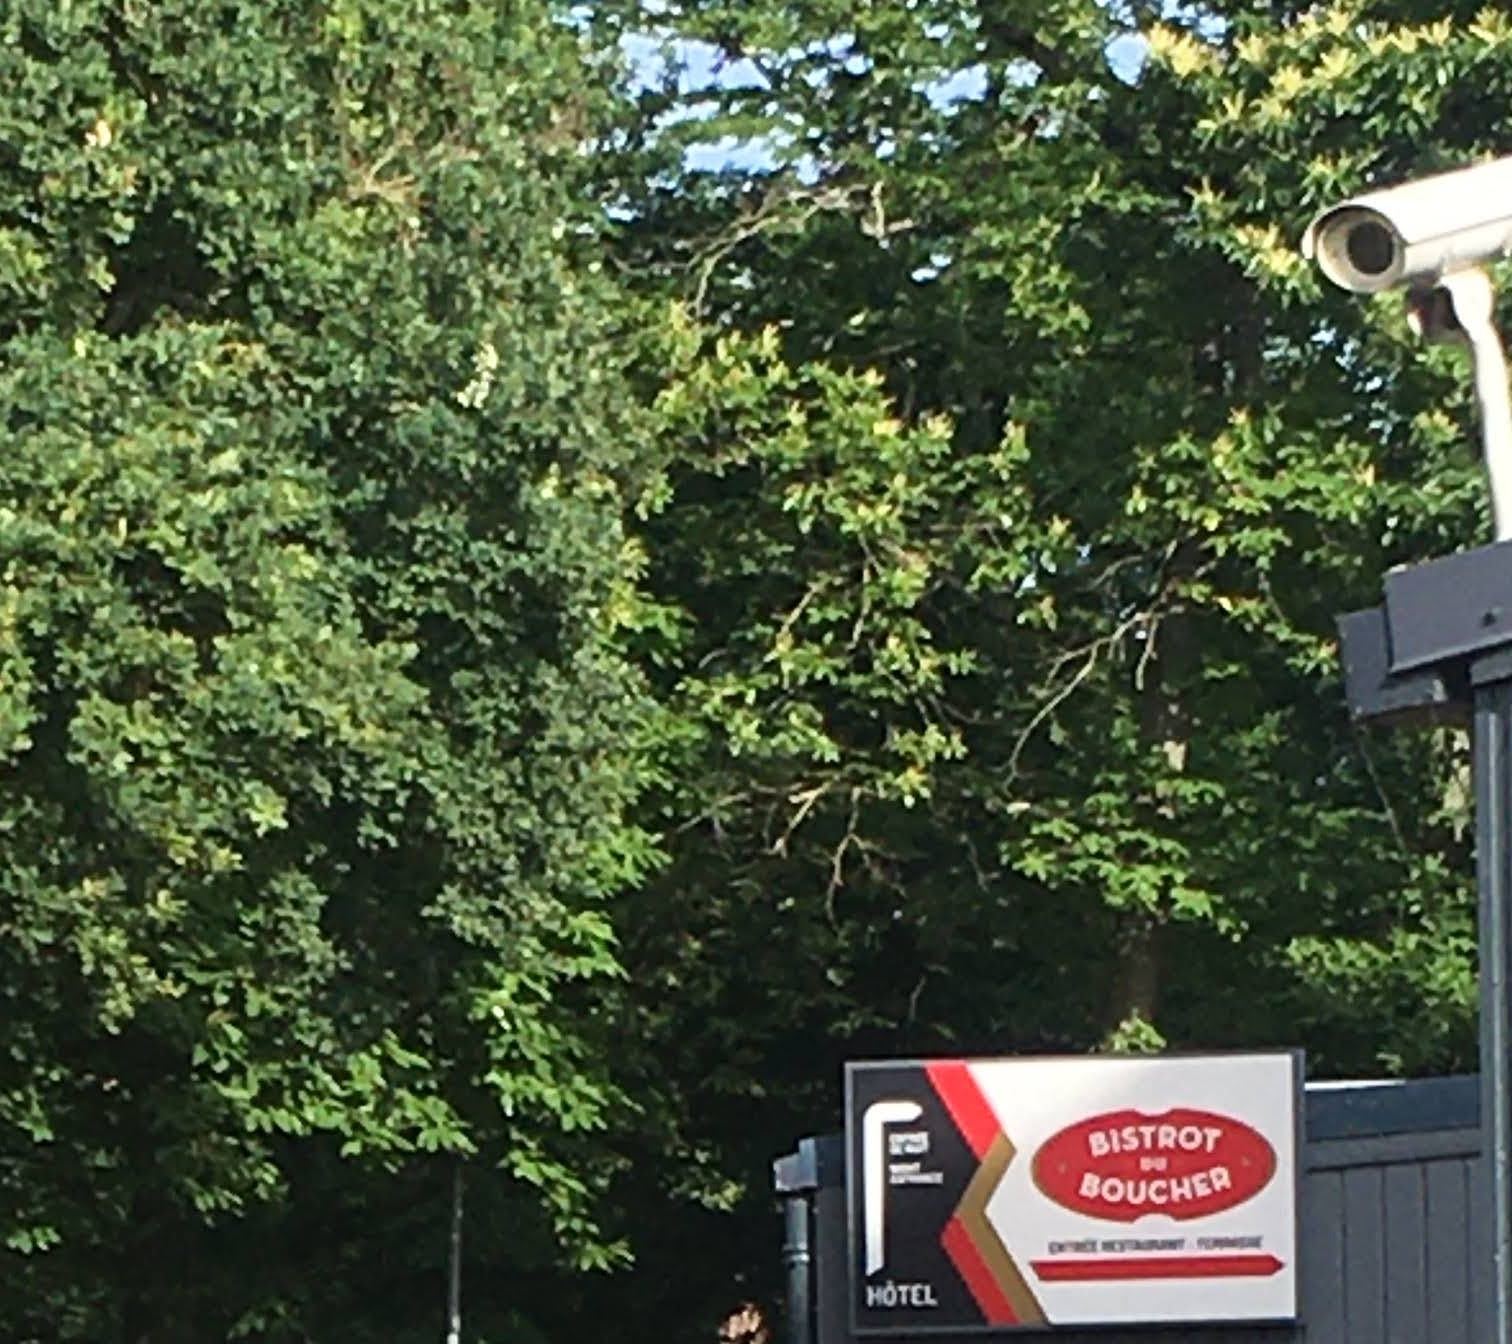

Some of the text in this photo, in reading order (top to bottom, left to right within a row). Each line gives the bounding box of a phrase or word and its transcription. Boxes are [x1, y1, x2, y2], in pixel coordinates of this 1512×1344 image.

[1088, 1123, 1223, 1158] BISTROT
[1078, 1165, 1232, 1205] BOUCHER
[866, 1279, 939, 1308] HÔTEL
